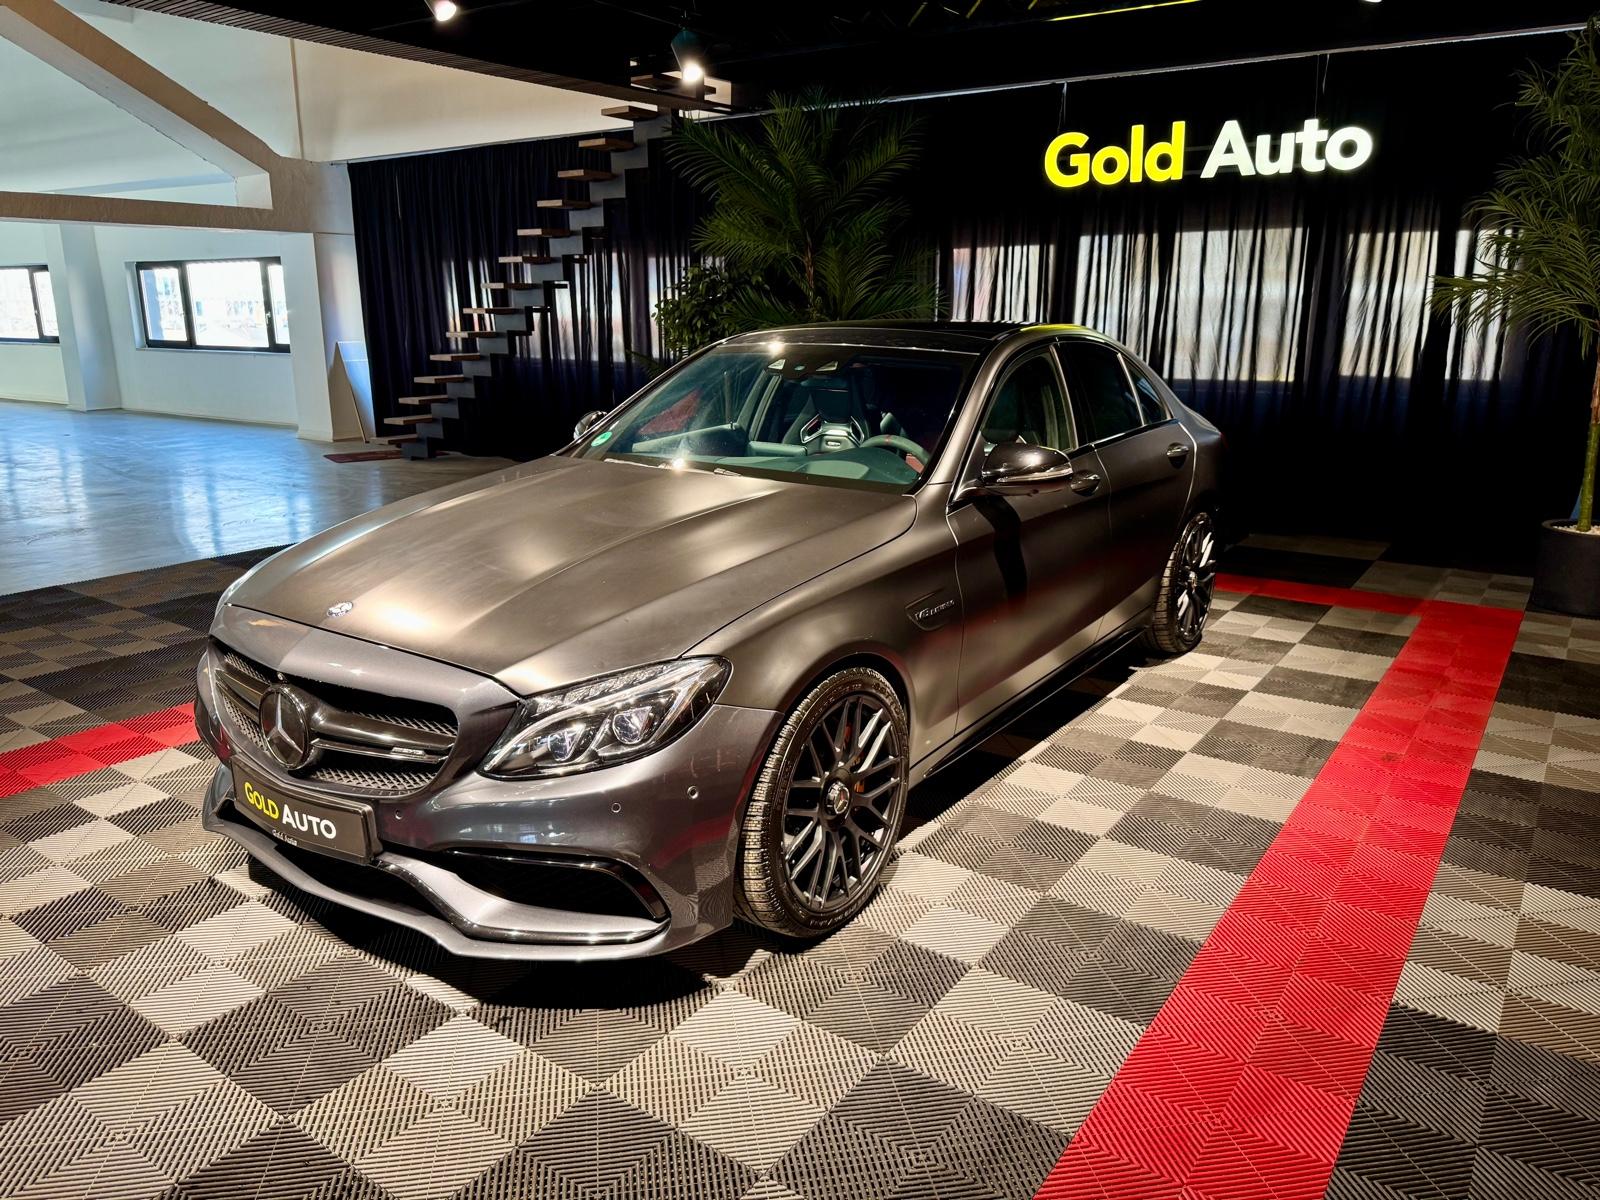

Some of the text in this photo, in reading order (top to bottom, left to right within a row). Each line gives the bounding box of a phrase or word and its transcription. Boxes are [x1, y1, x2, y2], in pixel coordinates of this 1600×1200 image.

[1044, 118, 1373, 188] Gold Auto
[244, 781, 338, 839] GOLD AUTO
